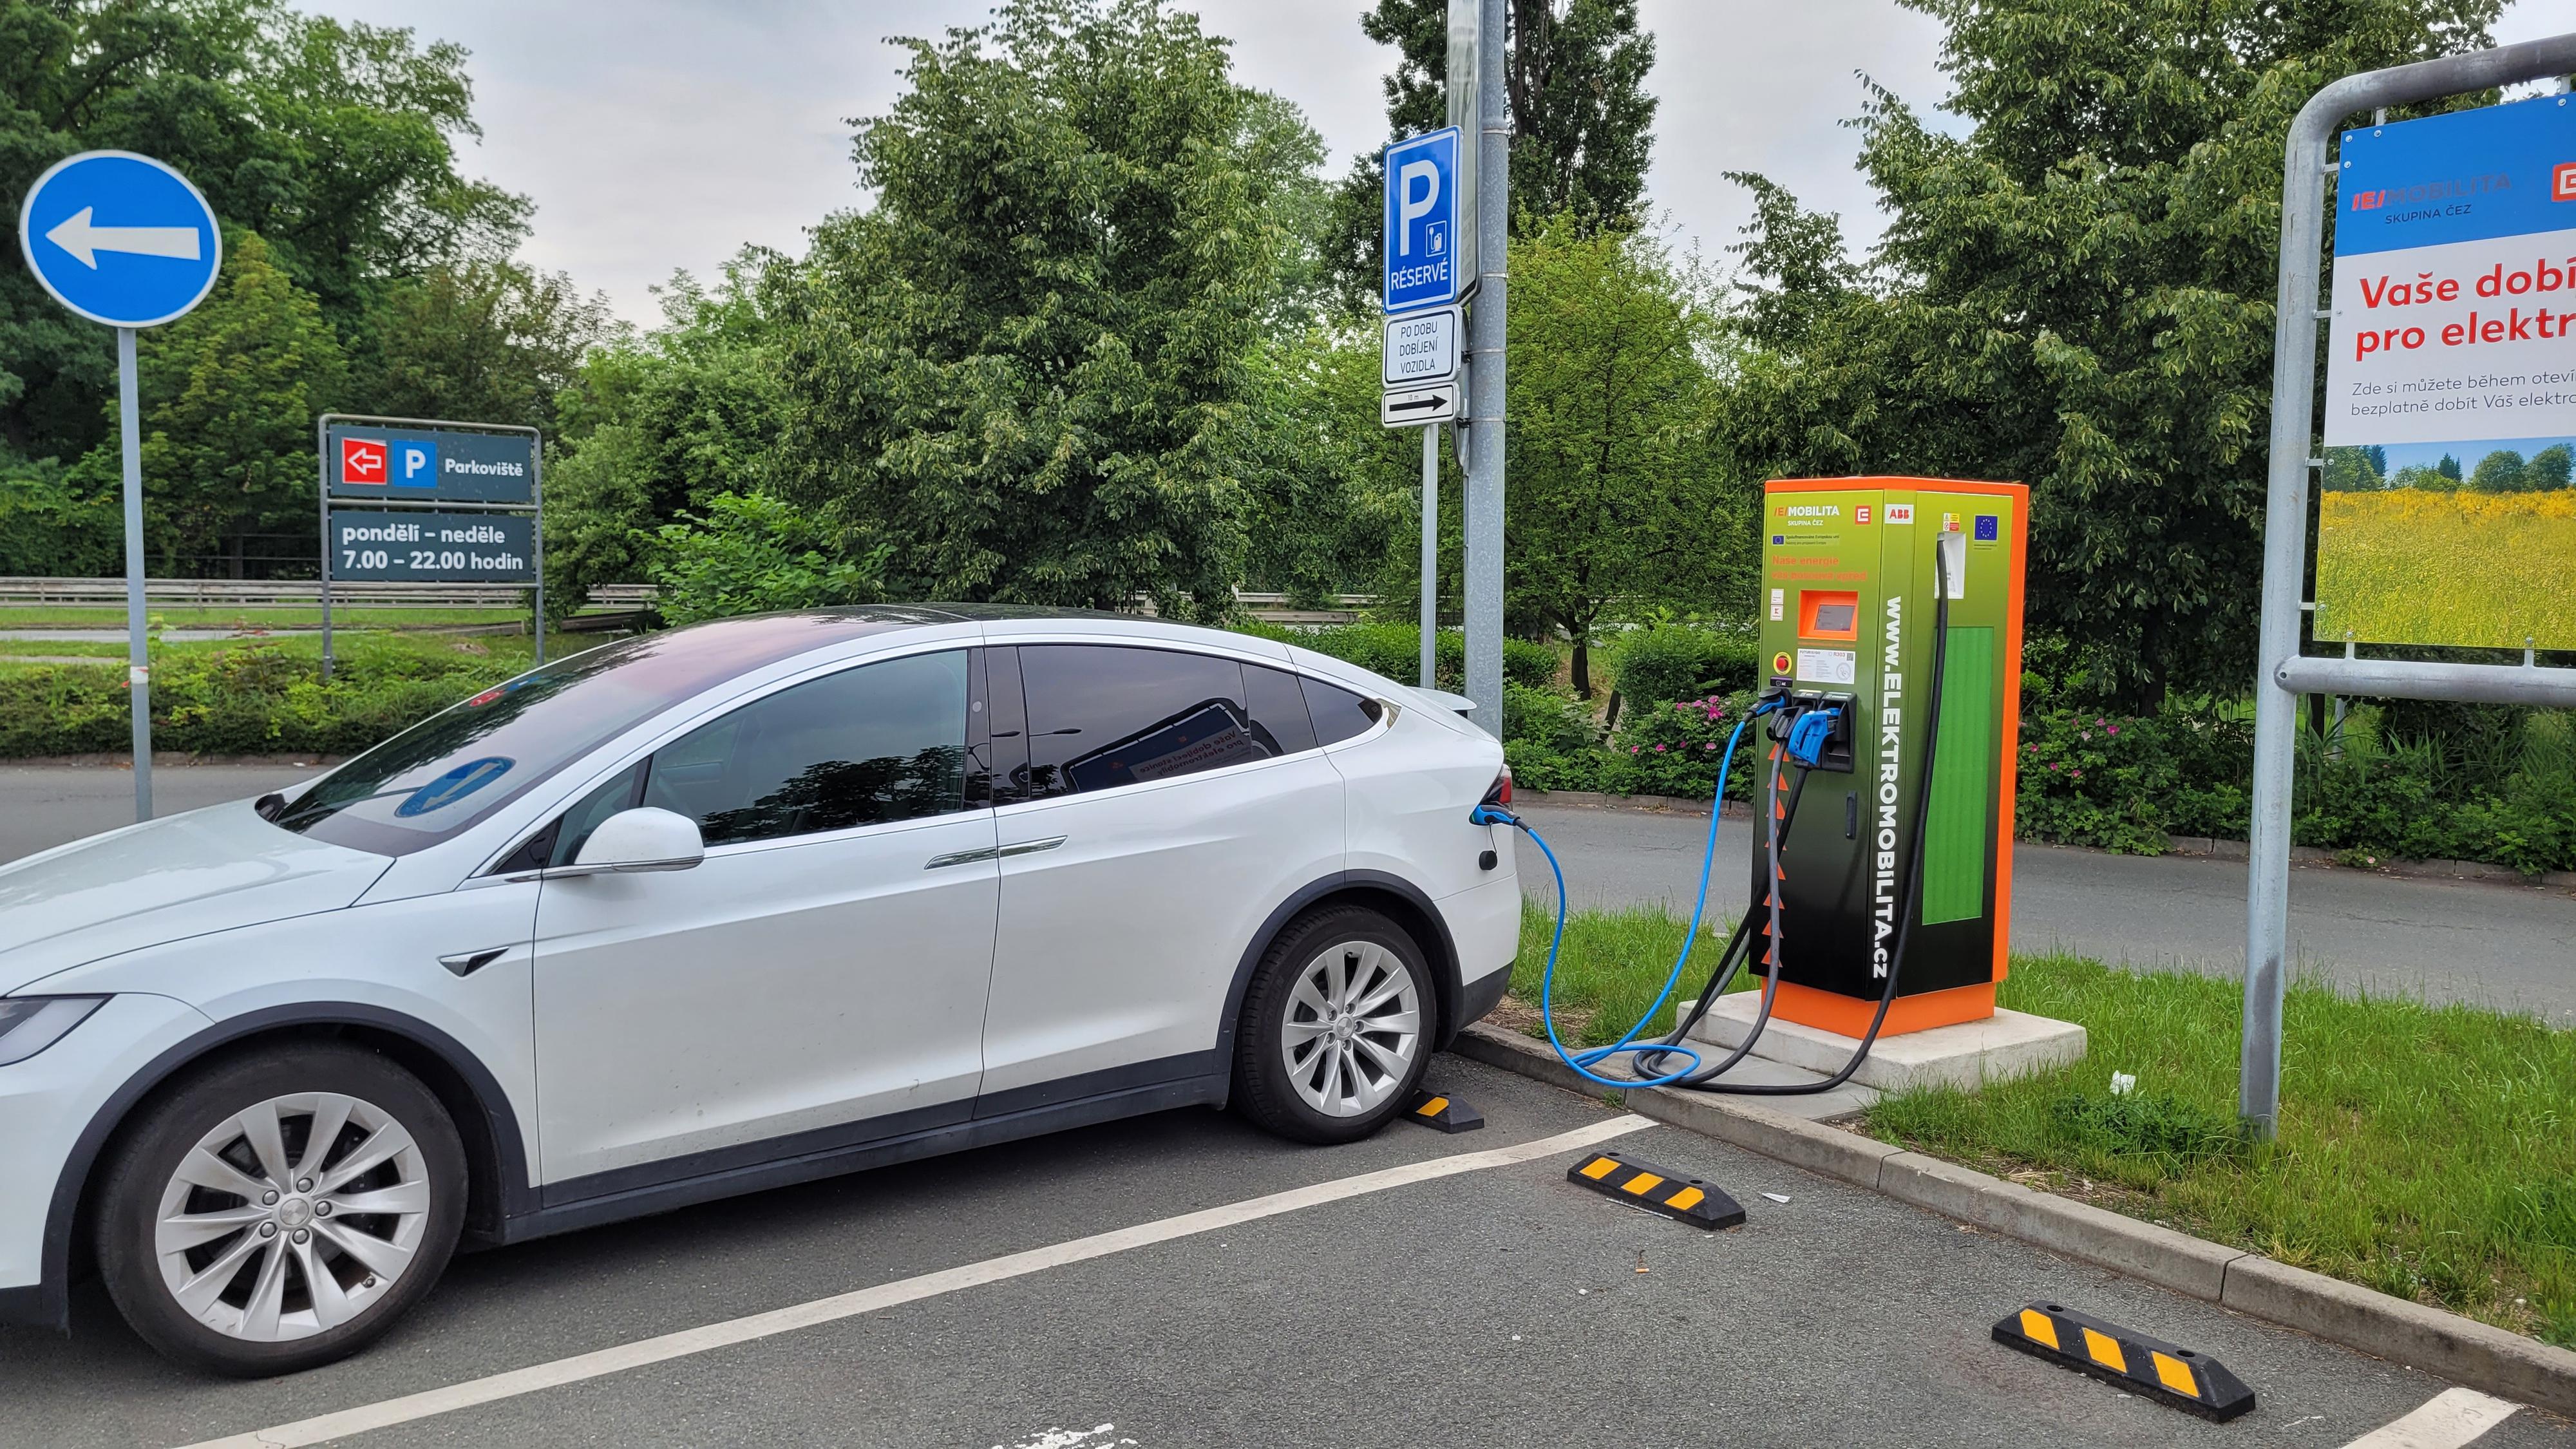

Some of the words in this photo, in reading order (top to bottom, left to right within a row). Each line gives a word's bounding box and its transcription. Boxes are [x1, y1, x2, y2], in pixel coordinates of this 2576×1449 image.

[1400, 159, 1440, 256] P
[2385, 209, 2441, 224] SKUPINA
[2445, 204, 2472, 216] ČEZ
[1391, 258, 1448, 290] RÉSERVÉ
[2360, 271, 2459, 308] Vaše
[2476, 256, 2576, 298] dobí
[1401, 327, 1412, 339] PO
[1414, 321, 1437, 337] DOBU
[2356, 327, 2425, 362] pro
[2441, 308, 2576, 346] elektr
[1399, 336, 1439, 357] DOBÍJENÍ
[1401, 359, 1435, 374] VOZIDLA
[2352, 382, 2382, 395] Zde
[2387, 381, 2397, 393] si
[2403, 378, 2462, 392] můžete
[2468, 374, 2525, 388] během
[2532, 369, 2576, 384] oteví
[2351, 399, 2429, 417] bezplatně
[2435, 397, 2477, 411] dobít
[2484, 394, 2513, 408] Váš
[2519, 392, 2576, 406] elektro
[405, 449, 426, 478] P
[445, 459, 523, 477] Parkoviště
[1889, 509, 1909, 520] ABB
[343, 524, 420, 545] pondělí
[441, 526, 505, 544] neděle
[343, 550, 388, 569] 7.00
[410, 551, 466, 570] 22.00
[471, 552, 523, 570] hodin
